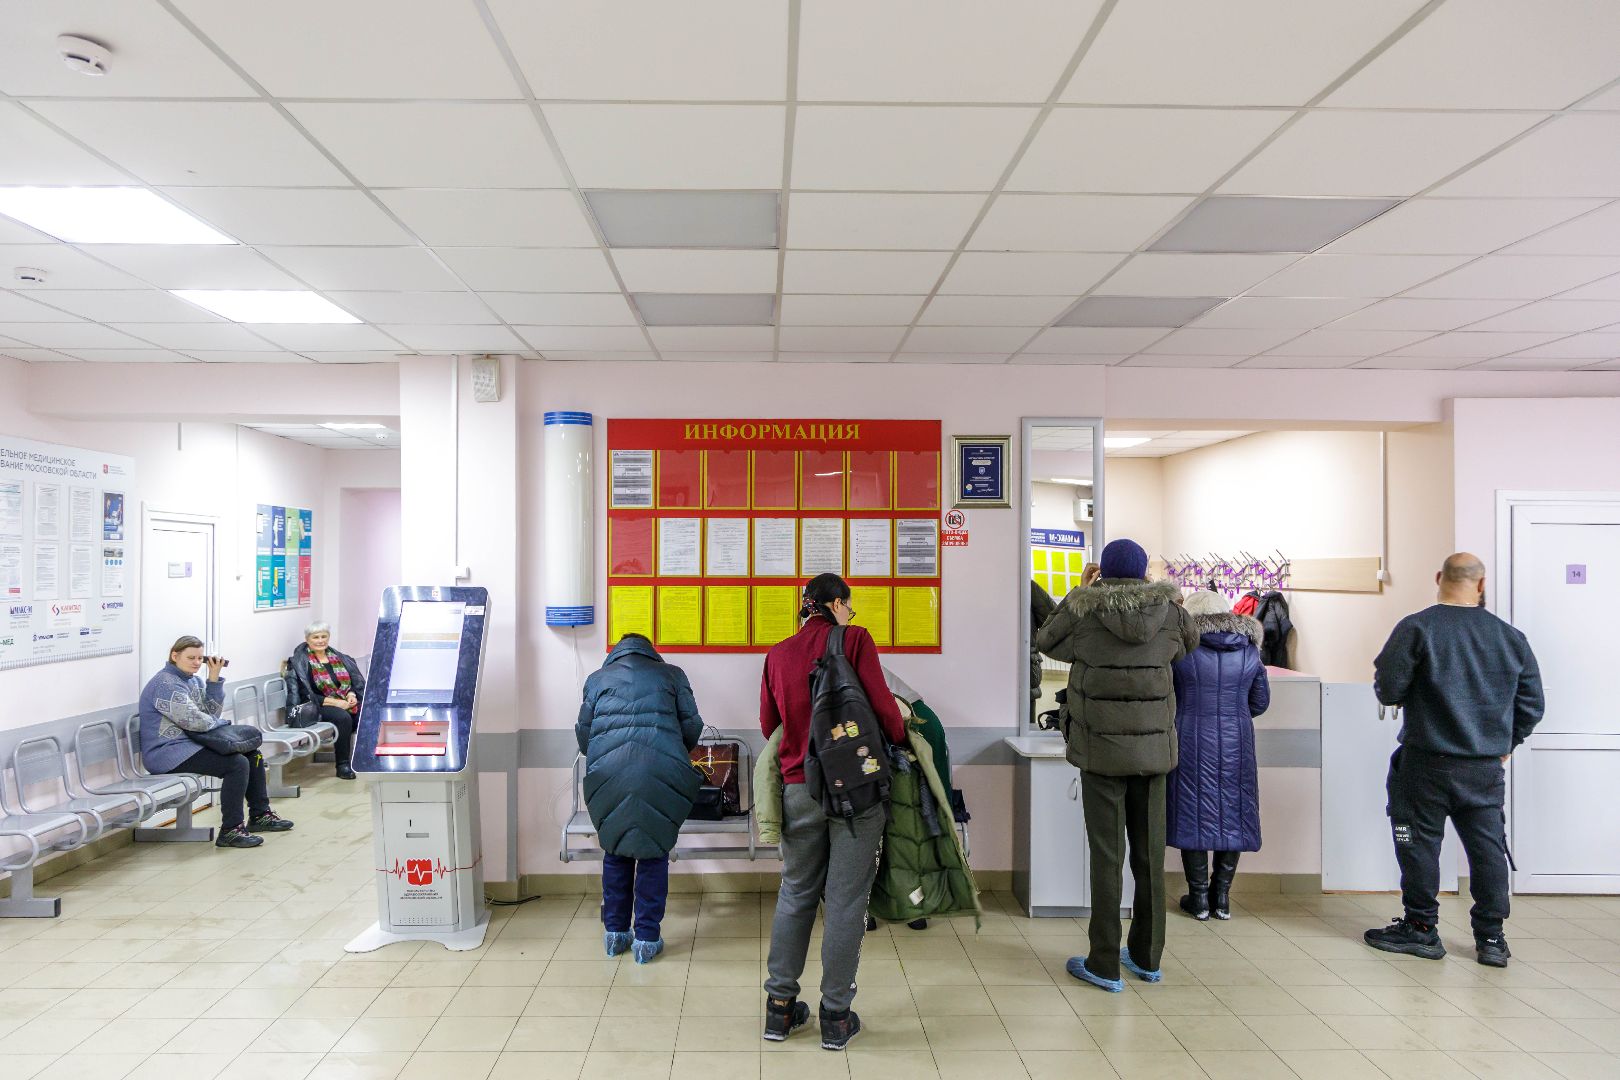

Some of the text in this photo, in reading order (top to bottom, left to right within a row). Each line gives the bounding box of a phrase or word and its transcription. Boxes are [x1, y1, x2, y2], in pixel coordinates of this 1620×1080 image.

[684, 424, 860, 444] ИНФОРМАЦИЯ
[29, 453, 76, 467] МЕДИЦИНСКОЕ
[25, 463, 69, 476] МОСКОВСКОЙ
[70, 469, 97, 480] ОБЛАСТИ
